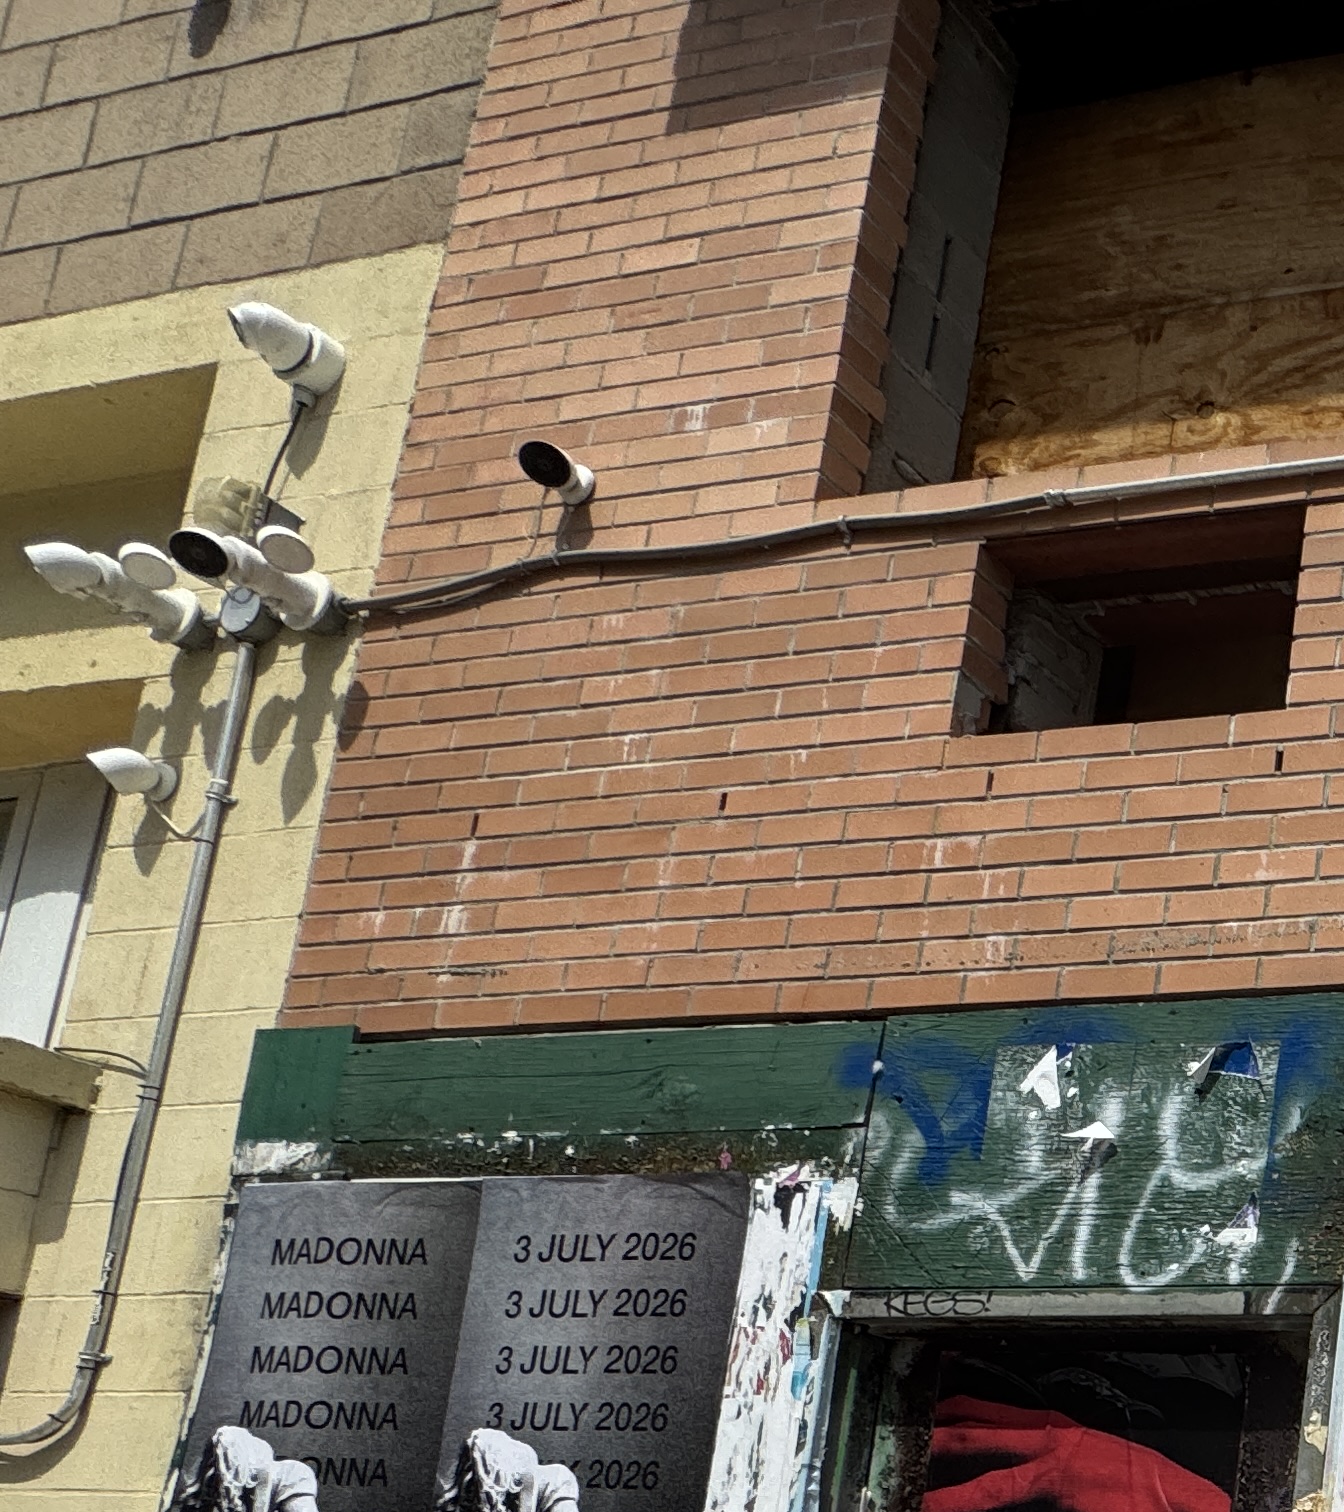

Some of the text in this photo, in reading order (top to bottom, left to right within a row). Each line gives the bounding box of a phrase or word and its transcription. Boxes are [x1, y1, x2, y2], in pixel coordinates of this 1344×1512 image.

[271, 1237, 428, 1266] MADONNA
[514, 1233, 696, 1263] 3 JULY 2026
[261, 1290, 417, 1320] MADONNA
[506, 1289, 687, 1317] 3 JULY 2026
[250, 1345, 408, 1375] MADONNA
[496, 1346, 678, 1375] 3 JULY 2026
[240, 1401, 398, 1430] MADONNA
[486, 1402, 669, 1432] 3 JULY 2026
[586, 1460, 660, 1490] 2026
